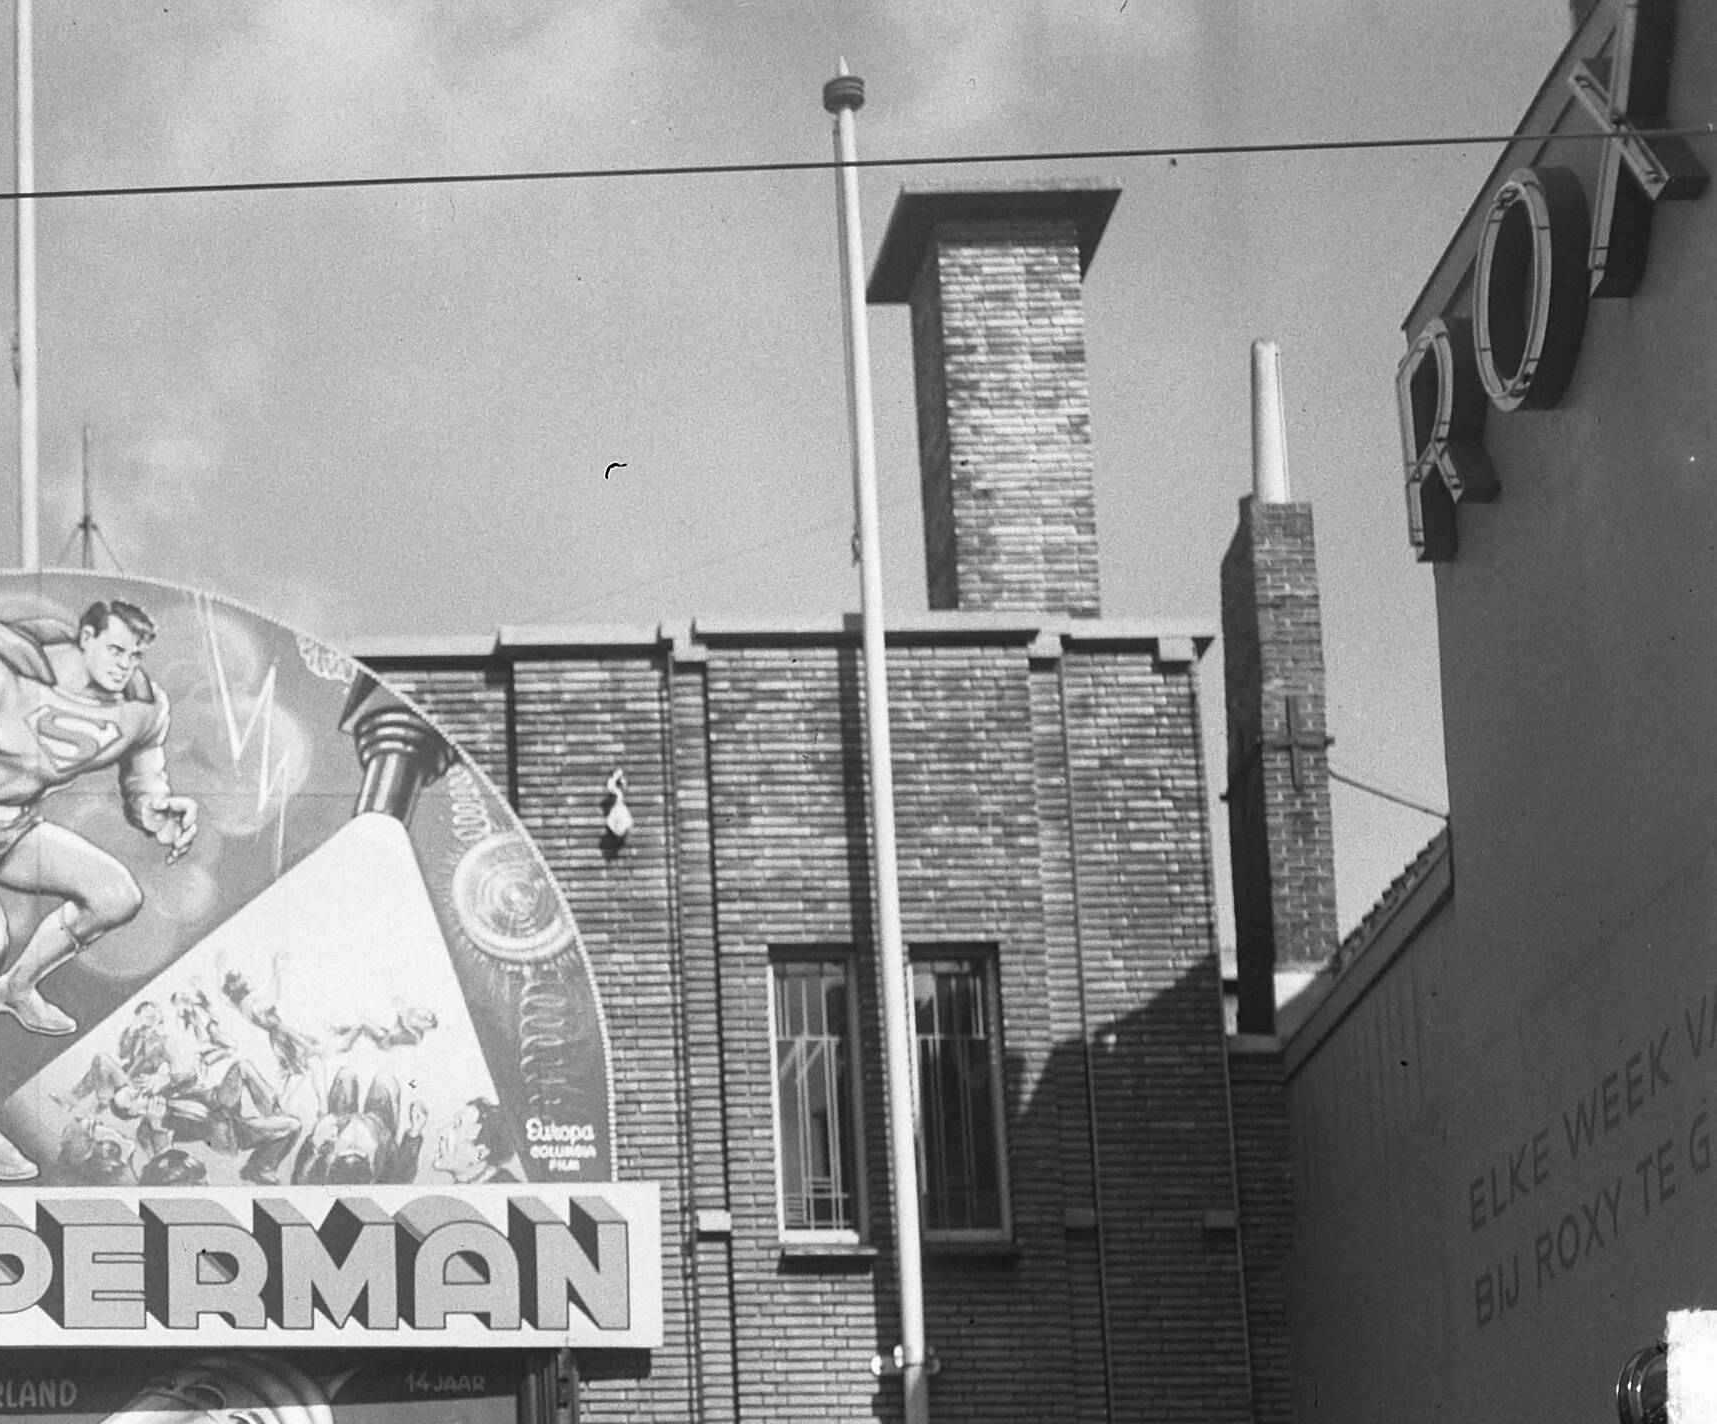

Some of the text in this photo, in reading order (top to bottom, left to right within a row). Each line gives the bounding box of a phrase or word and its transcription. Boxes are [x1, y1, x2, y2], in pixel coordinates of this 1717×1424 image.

[525, 1117, 597, 1145] Europa
[1469, 1127, 1551, 1234] ELKE
[1562, 1027, 1672, 1160] WEEK
[1474, 1252, 1520, 1328] BIJ
[1535, 1175, 1623, 1290] ROXY
[1635, 1138, 1677, 1217] TE
[403, 1370, 486, 1393] 14 JAAR
